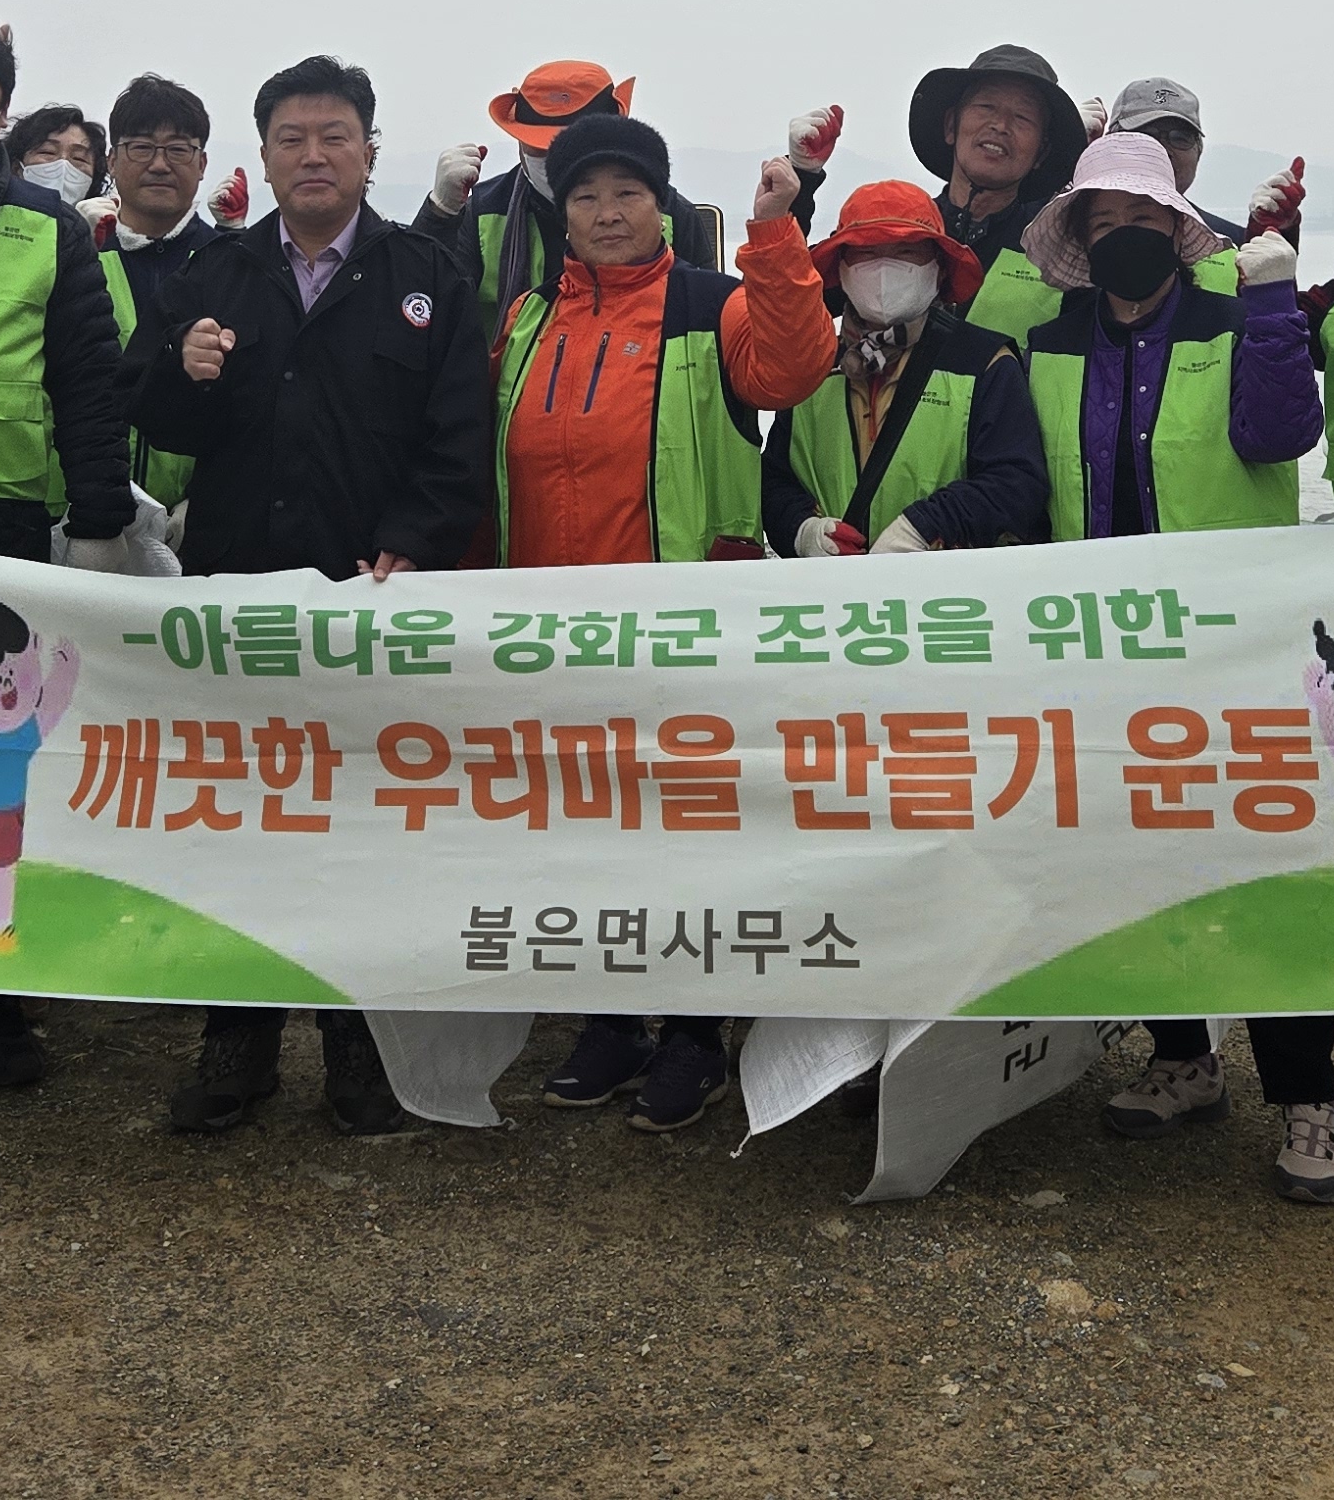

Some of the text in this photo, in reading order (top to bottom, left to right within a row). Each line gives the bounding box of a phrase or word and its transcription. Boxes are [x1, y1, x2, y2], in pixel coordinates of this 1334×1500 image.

[487, 608, 721, 674] 강화군
[754, 596, 994, 667] 조성을
[67, 706, 1320, 833] 깨끗한 우리마을 만들기 운동
[459, 905, 863, 976] 불은면사무소
